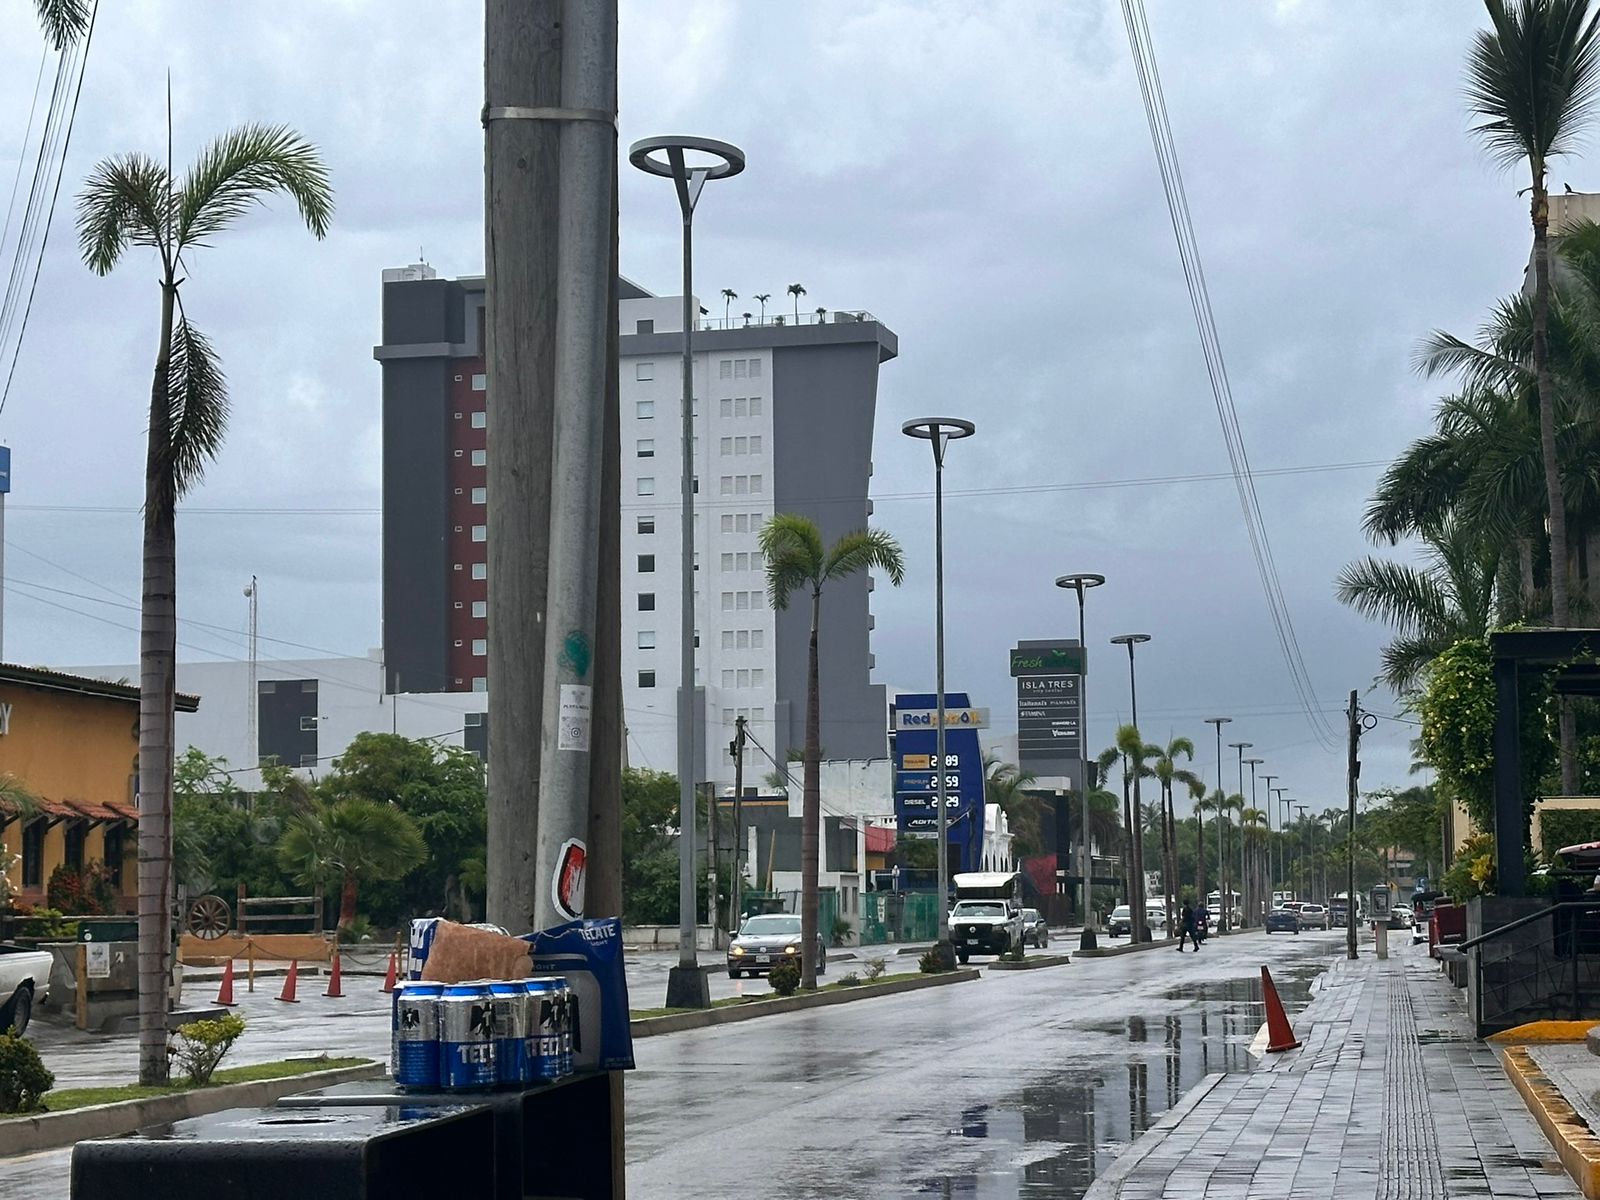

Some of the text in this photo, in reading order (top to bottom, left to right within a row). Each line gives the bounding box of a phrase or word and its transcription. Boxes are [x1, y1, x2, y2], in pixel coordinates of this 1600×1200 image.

[1022, 680, 1073, 690] ISLA TRES
[578, 923, 616, 940] TECATE
